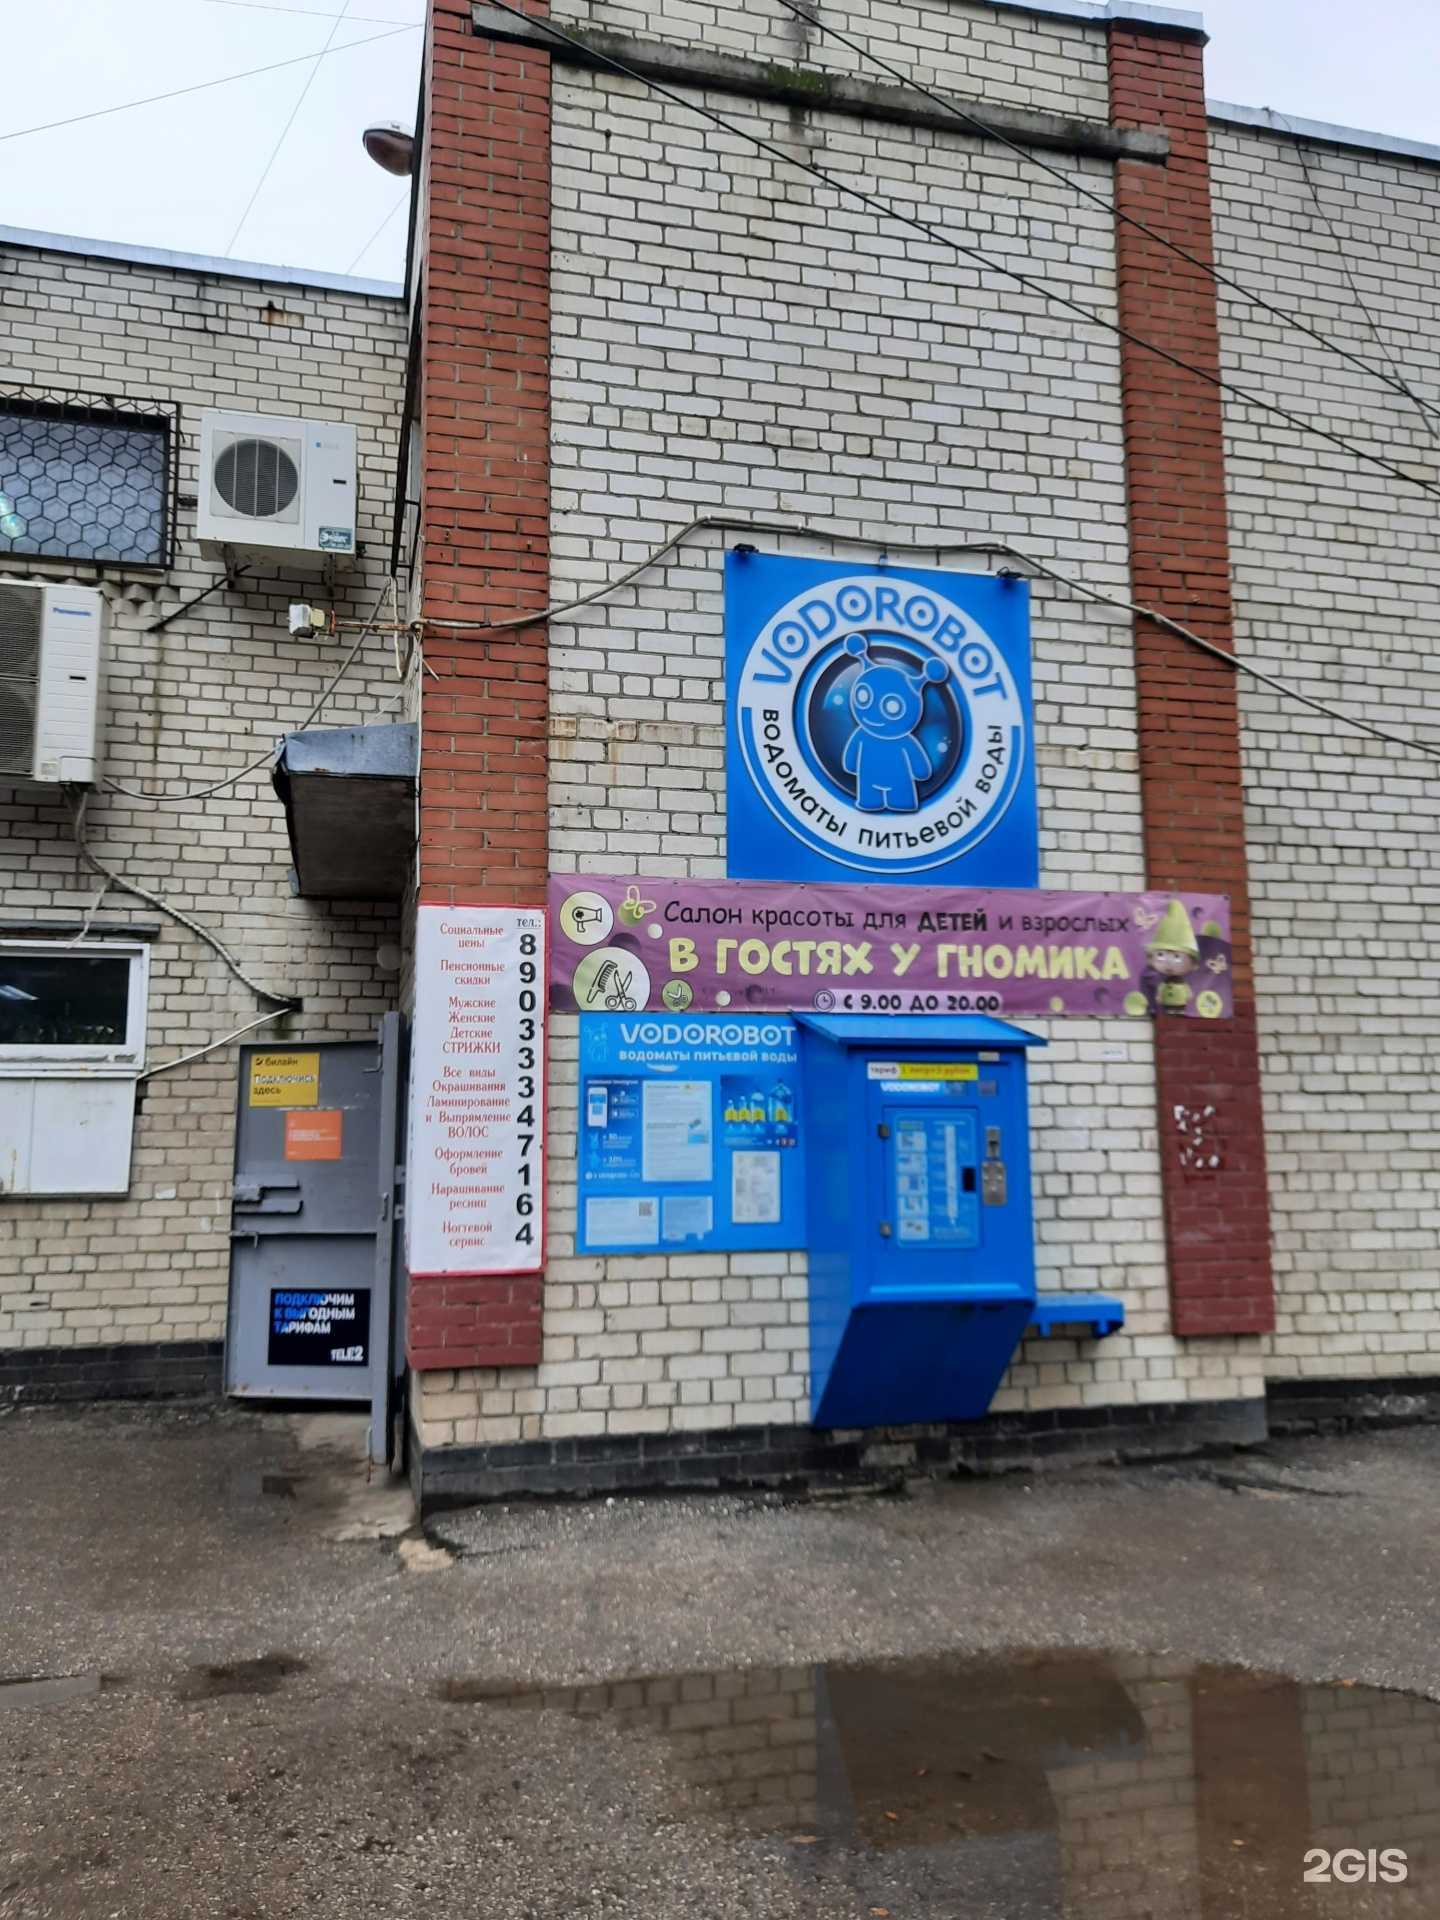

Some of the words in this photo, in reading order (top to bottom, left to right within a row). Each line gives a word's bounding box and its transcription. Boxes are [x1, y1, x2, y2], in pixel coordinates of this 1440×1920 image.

[753, 585, 1008, 699] VODOROBOT
[516, 918, 541, 928] тел.:
[664, 901, 742, 925] Салон
[752, 905, 854, 932] красоты
[862, 910, 907, 930] для
[918, 909, 988, 933] ДЕТЕЙ
[999, 915, 1013, 930] и
[1022, 916, 1129, 936] взрослых
[440, 922, 503, 935] Социальные
[458, 939, 485, 948] цены
[669, 937, 699, 973] В
[716, 938, 874, 977] ГОСТЯХ
[890, 942, 921, 977] У
[937, 943, 1129, 980] ГНОМИКА
[440, 959, 505, 972] Пенсионные
[454, 976, 490, 985] скидки
[448, 996, 496, 1010] Мужские
[843, 994, 853, 1009] С
[860, 994, 901, 1010] 9.00
[910, 994, 939, 1012] ДО
[947, 995, 999, 1011] 20.00
[448, 1011, 496, 1024] Женские
[450, 1027, 493, 1040] Детские
[620, 1023, 797, 1046] VODOROBOT
[442, 1042, 501, 1054] СТРИЖКИ
[619, 1050, 690, 1061] ВОДОМАТЫ
[694, 1050, 758, 1062] ПИТЬЕВОЙ
[762, 1052, 797, 1062] ВОДЫ
[443, 1065, 462, 1078] Все
[469, 1069, 496, 1078] виды
[432, 1079, 506, 1094] Окрашивания
[426, 1095, 511, 1110] Ламинирование
[425, 1114, 432, 1123] и
[439, 1111, 512, 1125] Выпрямление
[447, 1126, 489, 1138] ВОЛОС
[434, 1148, 503, 1160] Оформление
[449, 1163, 487, 1176] бровей
[443, 1221, 492, 1233] Ногтевой
[449, 1237, 485, 1248] сервис
[275, 1293, 354, 1305] ПОДКЛЮЧИМ
[274, 1307, 282, 1318] К
[274, 1321, 331, 1333] ТАРИФАМ
[331, 1346, 363, 1361] TELE2
